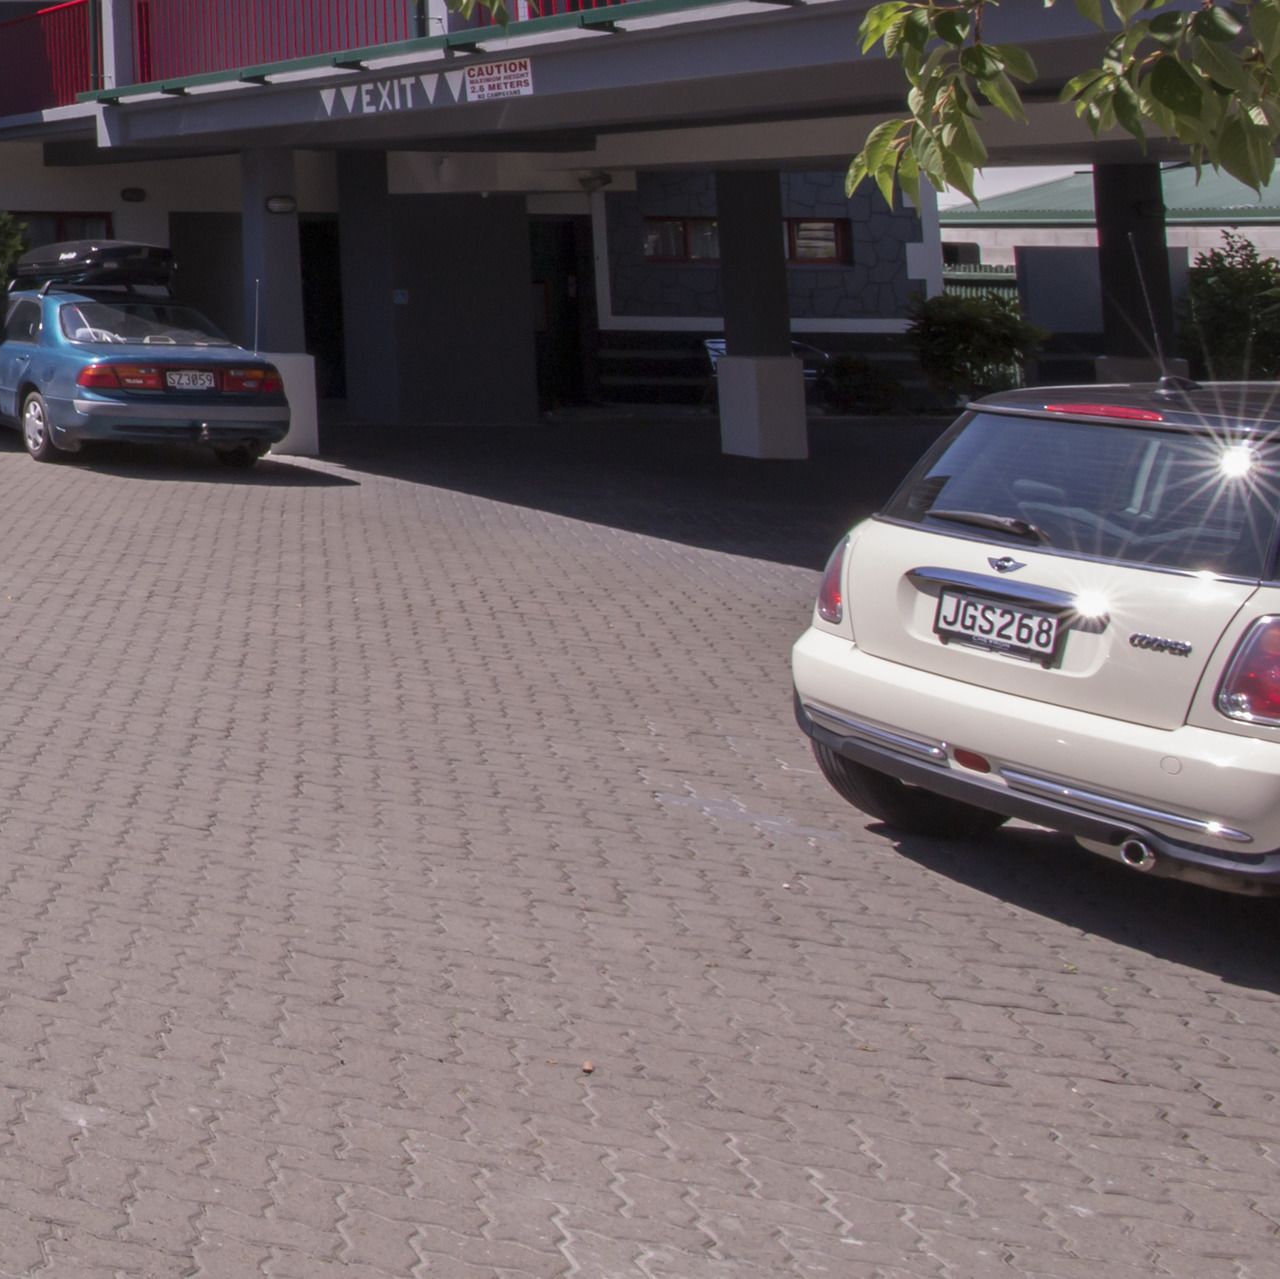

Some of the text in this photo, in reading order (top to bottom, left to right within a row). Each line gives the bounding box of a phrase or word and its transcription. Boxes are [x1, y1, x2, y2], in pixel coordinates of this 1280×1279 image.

[467, 60, 528, 78] CAUTION
[469, 72, 529, 85] MAXIMUM HEIGHT
[488, 79, 530, 92] METERS
[361, 77, 416, 113] EXIT
[168, 372, 214, 386] SZ3059
[943, 598, 1053, 649] JGS268
[1129, 633, 1193, 658] COOPER
